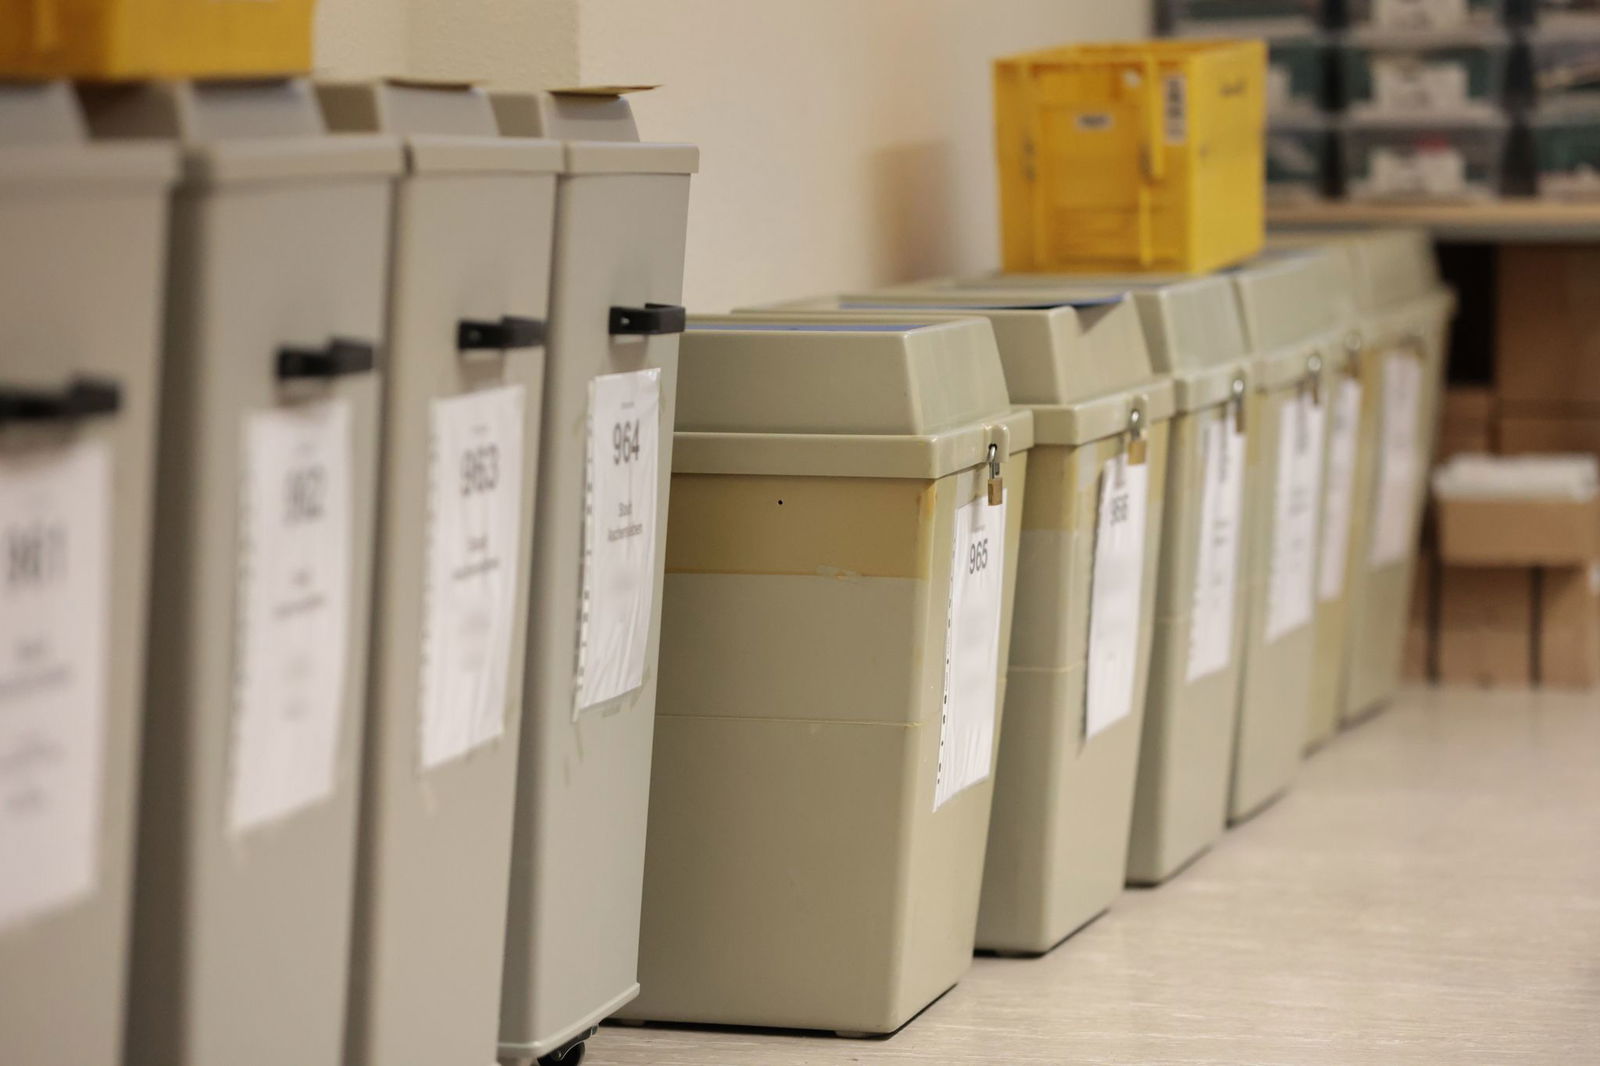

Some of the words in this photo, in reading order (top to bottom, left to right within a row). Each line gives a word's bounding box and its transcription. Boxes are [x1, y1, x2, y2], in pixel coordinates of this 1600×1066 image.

[613, 419, 640, 466] 964
[460, 444, 500, 497] 963
[970, 538, 989, 574] 965
